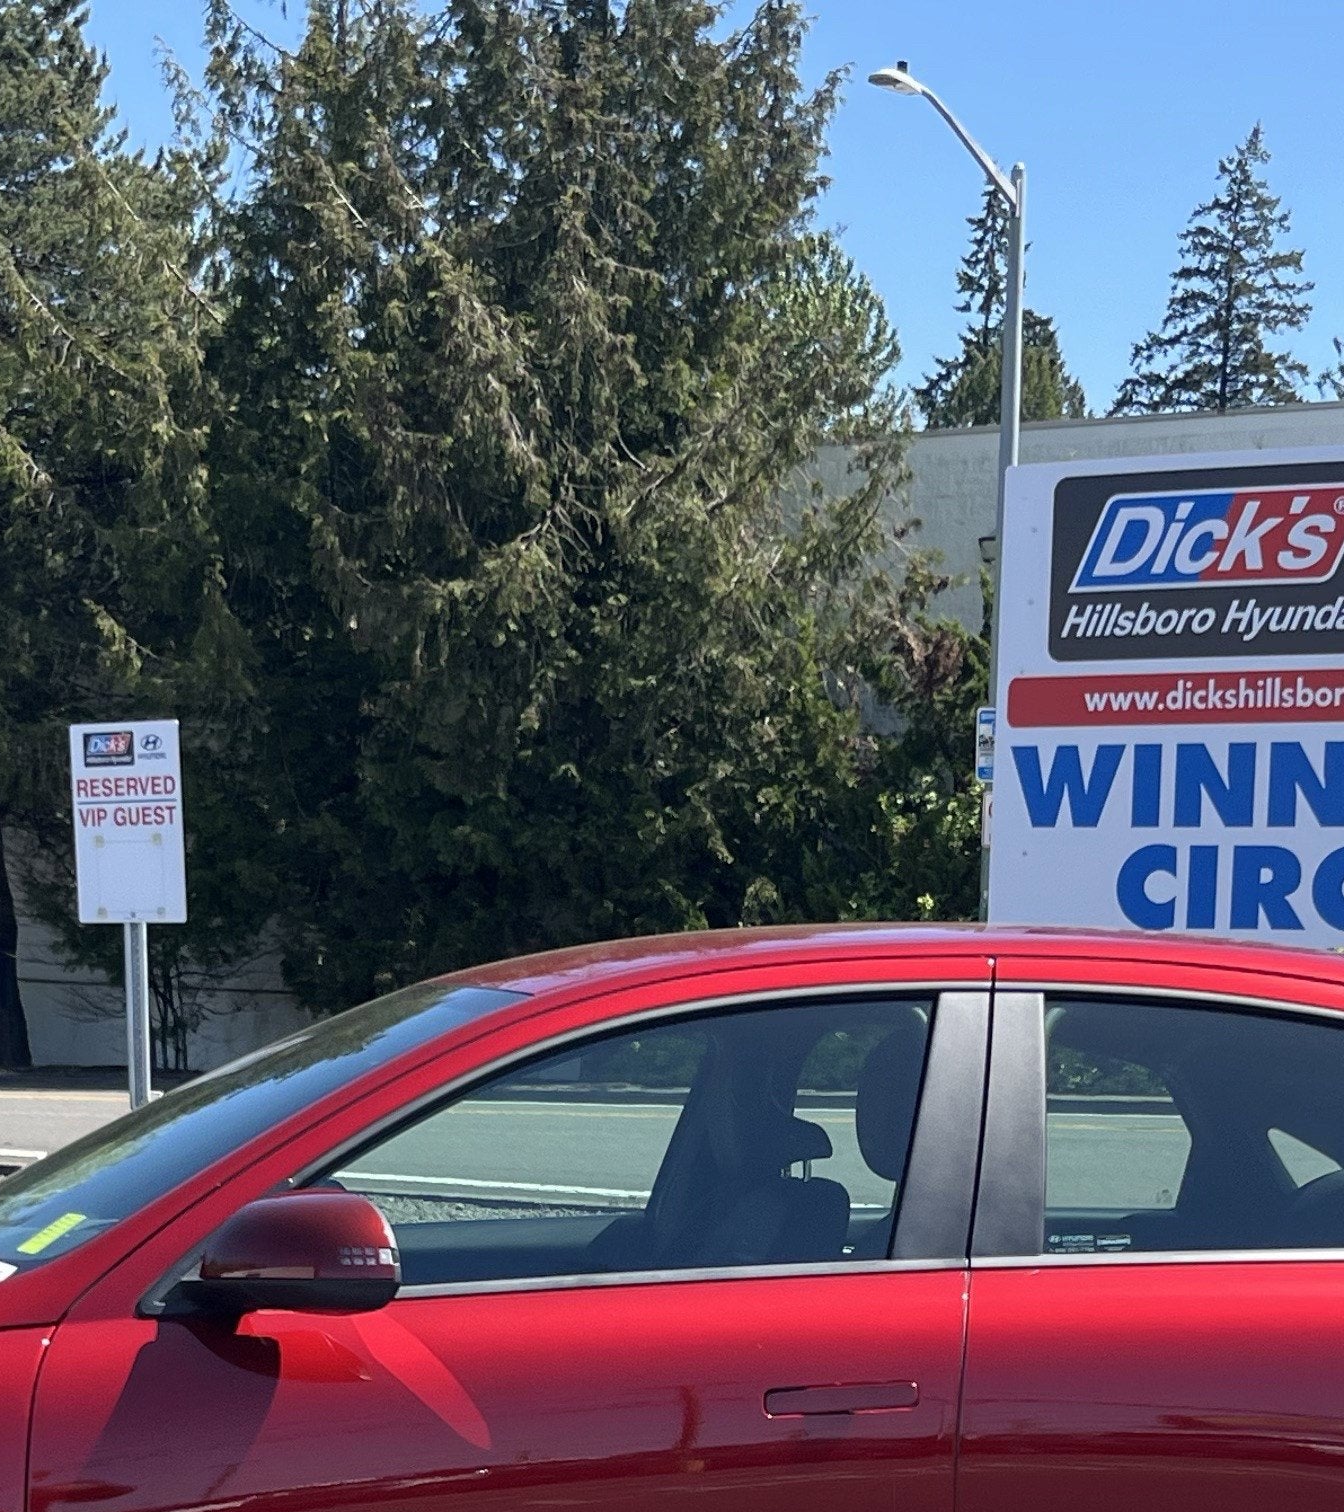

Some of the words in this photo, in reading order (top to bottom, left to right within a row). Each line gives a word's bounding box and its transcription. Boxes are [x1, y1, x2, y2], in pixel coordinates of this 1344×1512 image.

[1092, 496, 1337, 578] Dick's
[1060, 601, 1217, 639] Hillsboro
[76, 775, 176, 798] RESERVED
[78, 808, 107, 828] VIP
[113, 805, 177, 827] GUEST
